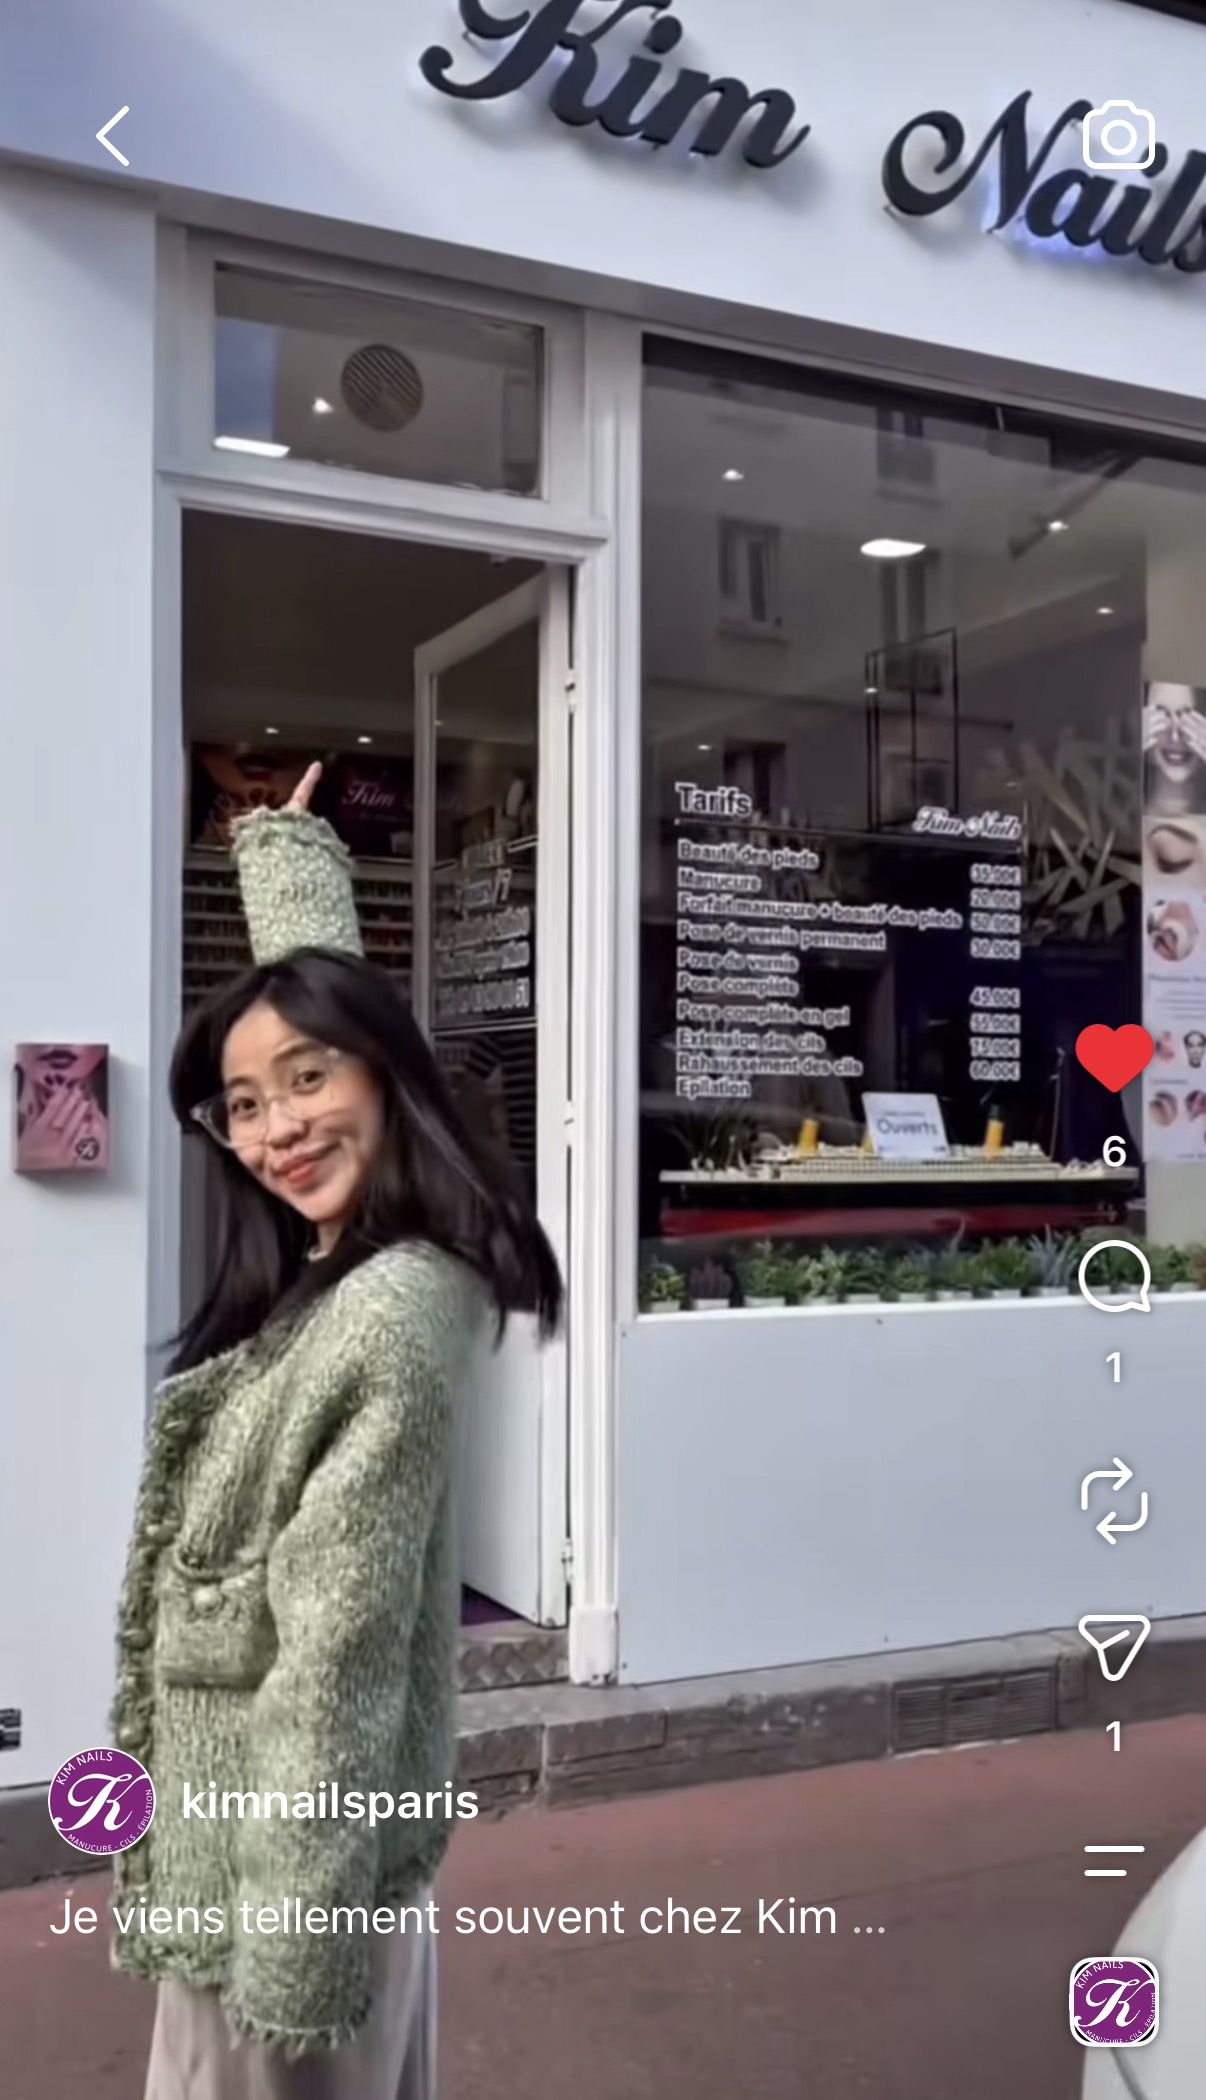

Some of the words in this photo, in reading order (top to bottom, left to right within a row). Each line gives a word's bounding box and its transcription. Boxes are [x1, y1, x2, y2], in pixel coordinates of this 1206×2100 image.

[418, 0, 811, 168] Kim
[675, 782, 752, 818] Tarifs
[677, 838, 739, 863] Beauté
[739, 844, 771, 866] des
[771, 848, 820, 871] pieds
[677, 866, 762, 893] Manucure
[677, 891, 734, 914] Forfait
[734, 898, 819, 920] manucure
[832, 901, 888, 924] beauté
[888, 906, 918, 926] des
[918, 907, 964, 931] pieds
[676, 918, 721, 943] Pose
[722, 921, 746, 943] de
[746, 925, 799, 946] vernis
[800, 930, 887, 951] permanent
[676, 946, 721, 970] Pose
[722, 949, 746, 970] de
[746, 952, 800, 973] vernis
[676, 970, 721, 994] Pose
[676, 998, 721, 1022] Pose
[800, 1008, 822, 1026] en
[822, 1005, 851, 1030] gel
[676, 1027, 761, 1050] Extension
[761, 1031, 797, 1052] des
[797, 1031, 827, 1053] cils
[800, 1056, 832, 1077] des
[832, 1056, 864, 1077] cils
[877, 1118, 938, 1135] Ouverts
